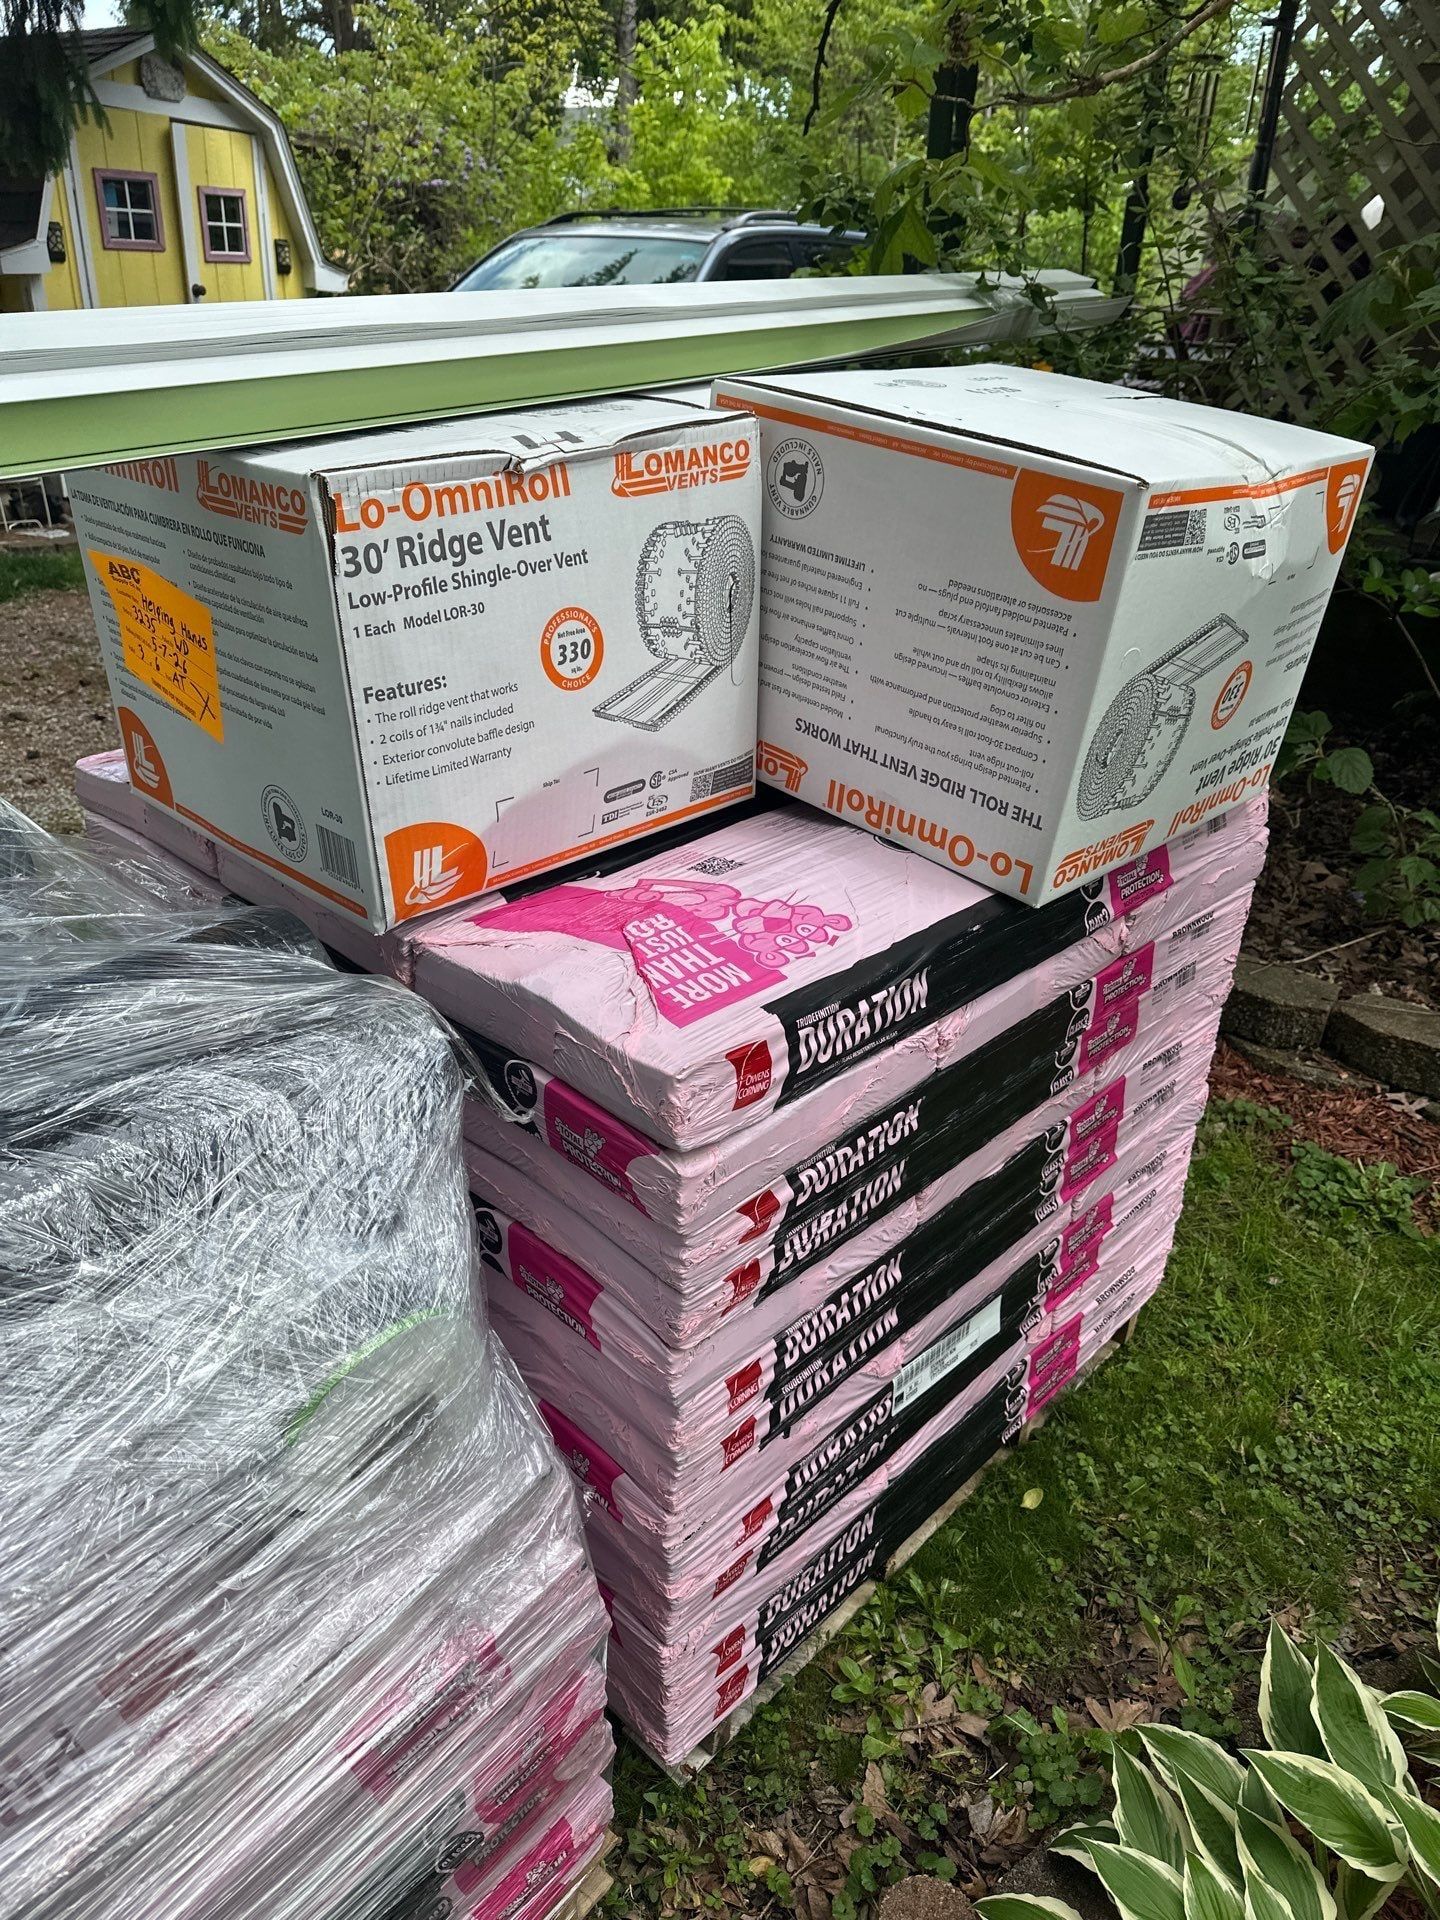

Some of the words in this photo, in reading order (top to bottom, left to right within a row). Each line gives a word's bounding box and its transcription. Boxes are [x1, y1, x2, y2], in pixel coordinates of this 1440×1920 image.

[615, 439, 750, 482] LOMANCO
[773, 441, 807, 463] INCLUDED
[807, 448, 822, 476] NAILS
[197, 459, 306, 516] LOMANCO
[665, 467, 719, 491] VENTS
[333, 463, 570, 533] Lo-OmniRoll
[768, 484, 782, 507] VENT
[781, 494, 816, 518] GUNNABLE
[91, 494, 100, 506] DE
[133, 507, 149, 523] PARA
[180, 522, 192, 536] EN
[190, 524, 212, 542] ROLLO
[212, 531, 227, 547] QUE
[227, 535, 265, 558] FUNCIONA
[235, 507, 278, 529] VENTS
[340, 538, 389, 578] 30'
[395, 527, 483, 568] Ridge
[485, 514, 551, 550] Vent
[767, 530, 805, 552] WARRANTY
[806, 545, 834, 561] LIMITED
[834, 554, 865, 571] LIFETIME
[108, 560, 140, 585] ABC
[347, 575, 447, 609] Low-Profile
[451, 558, 552, 590] Shingle-Over
[552, 548, 588, 568] Vent
[917, 583, 927, 591] no
[937, 588, 959, 601] plugs
[947, 578, 976, 593] needed
[976, 587, 1017, 606] alterations
[958, 595, 974, 605] end
[973, 600, 1001, 616] fanfold
[1017, 600, 1026, 608] or
[352, 626, 359, 638] 1
[364, 620, 395, 636] Each
[403, 609, 441, 629] Model
[443, 601, 484, 621] LOR-30
[1001, 608, 1032, 623] molded
[1027, 602, 1072, 621] accessories
[543, 609, 598, 646] PROFESSIONAL'S
[1032, 618, 1069, 636] Patented
[557, 638, 592, 667] 330
[362, 675, 447, 704] Features:
[561, 672, 592, 689] CHOICE
[869, 674, 884, 685] with
[884, 680, 928, 700] performance
[374, 711, 396, 723] The
[399, 705, 416, 719] roll
[418, 701, 445, 715] ridge
[446, 694, 468, 708] vent
[469, 688, 489, 702] that
[490, 681, 518, 697] works
[927, 695, 942, 705] and
[1222, 681, 1245, 703] 330
[908, 707, 932, 723] handle
[932, 716, 940, 725] to
[942, 701, 979, 719] protection
[989, 703, 1006, 716] clog
[1006, 711, 1015, 720] to
[379, 734, 386, 744] 2
[389, 728, 413, 742] coils
[415, 724, 426, 737] of
[450, 714, 472, 728] nails
[473, 702, 513, 723] included
[940, 718, 957, 730] easy
[957, 725, 964, 735] is
[963, 728, 976, 737] roll
[979, 714, 1009, 730] weather
[1015, 715, 1034, 728] filter
[1034, 721, 1045, 730] no
[382, 749, 424, 765] Exterior
[427, 736, 475, 755] convolute
[476, 727, 503, 742] baffle
[504, 720, 534, 735] design
[795, 717, 841, 749] WORKS
[874, 725, 907, 744] functional
[907, 736, 923, 749] truly
[976, 732, 1004, 749] 30-foot
[1010, 725, 1043, 743] Superior
[842, 738, 878, 764] THAT
[924, 744, 935, 754] the
[936, 749, 950, 759] you
[969, 749, 985, 760] vent
[1004, 742, 1038, 761] Compact
[1227, 745, 1262, 775] Ridge
[385, 769, 429, 785] Lifetime
[431, 756, 468, 776] Limited
[469, 746, 511, 765] Warranty
[879, 753, 917, 780] VENT
[950, 754, 973, 770] brings
[973, 763, 997, 778] design
[986, 755, 1005, 769] ridge
[1005, 763, 1034, 778] roll-out
[919, 768, 966, 799] RIDGE
[997, 772, 1031, 792] Patented
[1194, 764, 1226, 795] Vent
[969, 787, 1009, 816] ROLL
[1167, 764, 1271, 836] Lo-OmniRoll
[1010, 804, 1042, 830] THE
[824, 780, 1032, 892] Lo-OmniRoll
[1084, 832, 1122, 859] VENTS
[1053, 836, 1147, 889] LOMANCO
[1120, 869, 1161, 899] PROTECTION
[636, 926, 695, 959] JUST
[640, 943, 726, 989] THAN
[661, 962, 753, 1009] MORE
[795, 1001, 841, 1029] TRUDEFINITION
[796, 967, 930, 1075] DURATION
[745, 1068, 771, 1086] OWENS
[738, 1080, 771, 1100] CORNING
[796, 1098, 923, 1206] DURATION
[784, 1251, 903, 1369] DURATION
[765, 1507, 878, 1628] DURATION
